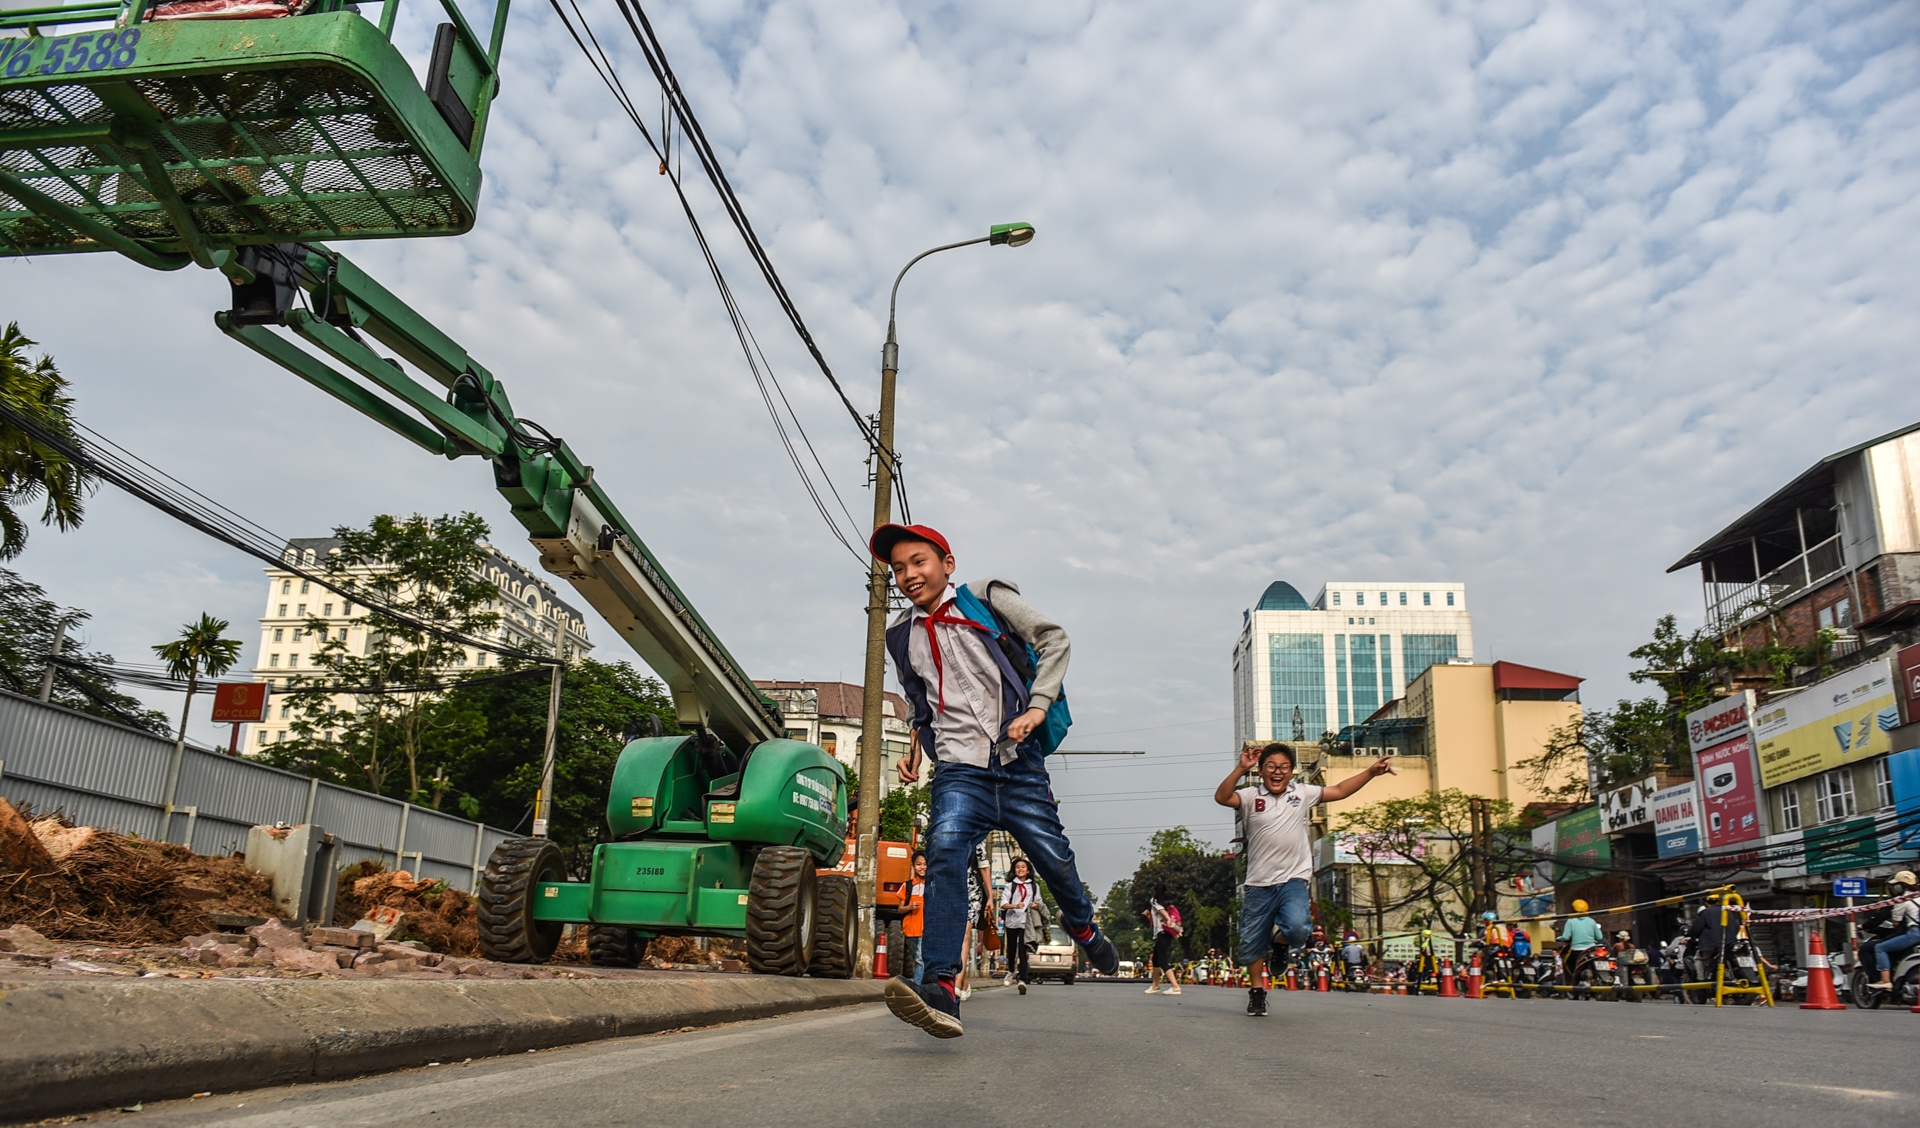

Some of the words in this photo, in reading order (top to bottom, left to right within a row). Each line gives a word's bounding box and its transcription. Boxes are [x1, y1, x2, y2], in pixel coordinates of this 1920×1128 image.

[40, 28, 141, 75] 5588
[215, 709, 229, 717] OV
[231, 709, 260, 718] CLUB
[1703, 705, 1747, 736] PICENZA
[1255, 798, 1266, 812] B
[1609, 809, 1627, 829] GỐM
[1630, 805, 1646, 824] VIỆT
[1655, 804, 1680, 825] OANH
[1681, 798, 1694, 818] HÀ
[637, 867, 665, 876] 235180
